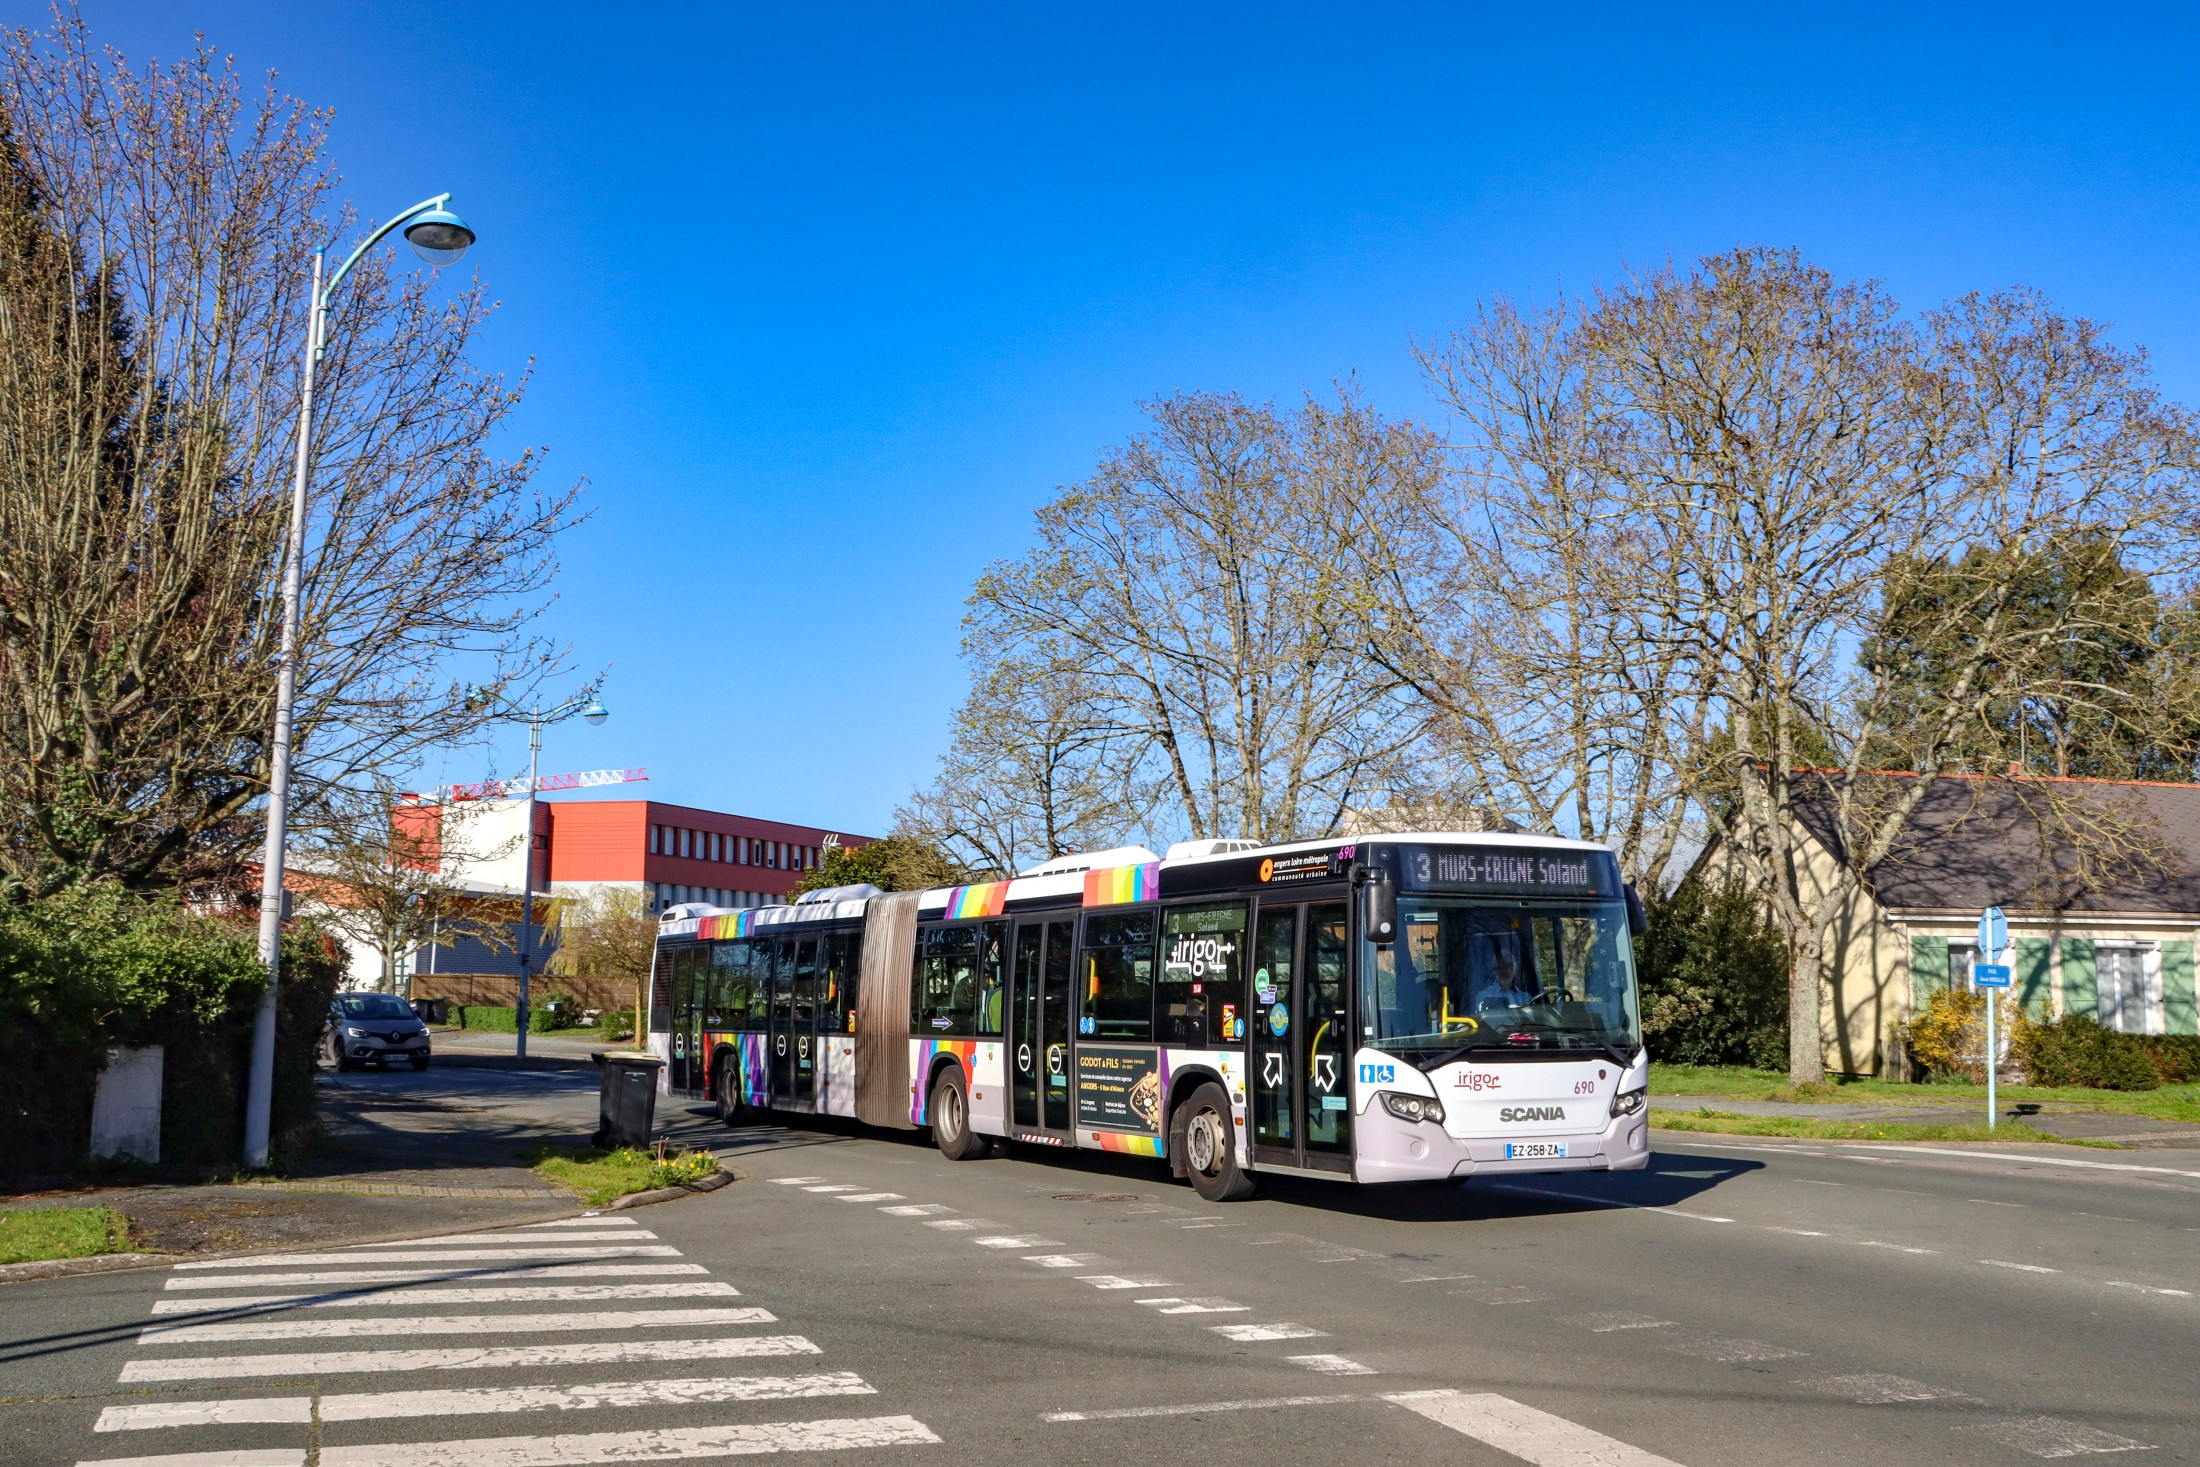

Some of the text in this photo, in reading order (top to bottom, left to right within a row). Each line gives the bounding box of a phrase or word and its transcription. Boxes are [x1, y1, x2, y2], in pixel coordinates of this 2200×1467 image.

[1338, 846, 1355, 860] 690
[1274, 860, 1290, 869] angers
[1303, 854, 1329, 865] métropole
[1272, 870, 1328, 881] communauté urbaine
[1416, 853, 1589, 886] 3 MURS-ERIGNE Soland
[1172, 914, 1180, 934] 3
[1197, 921, 1219, 932] Soland
[1080, 1056, 1102, 1068] GODOT
[1106, 1057, 1119, 1069] FILS
[1080, 1082, 1097, 1090] ANGERS
[1458, 1071, 1493, 1092] irigo
[1574, 1081, 1595, 1095] 690
[1499, 1106, 1566, 1122] SCANIA
[1512, 1144, 1559, 1157] EZ-258-ZA
